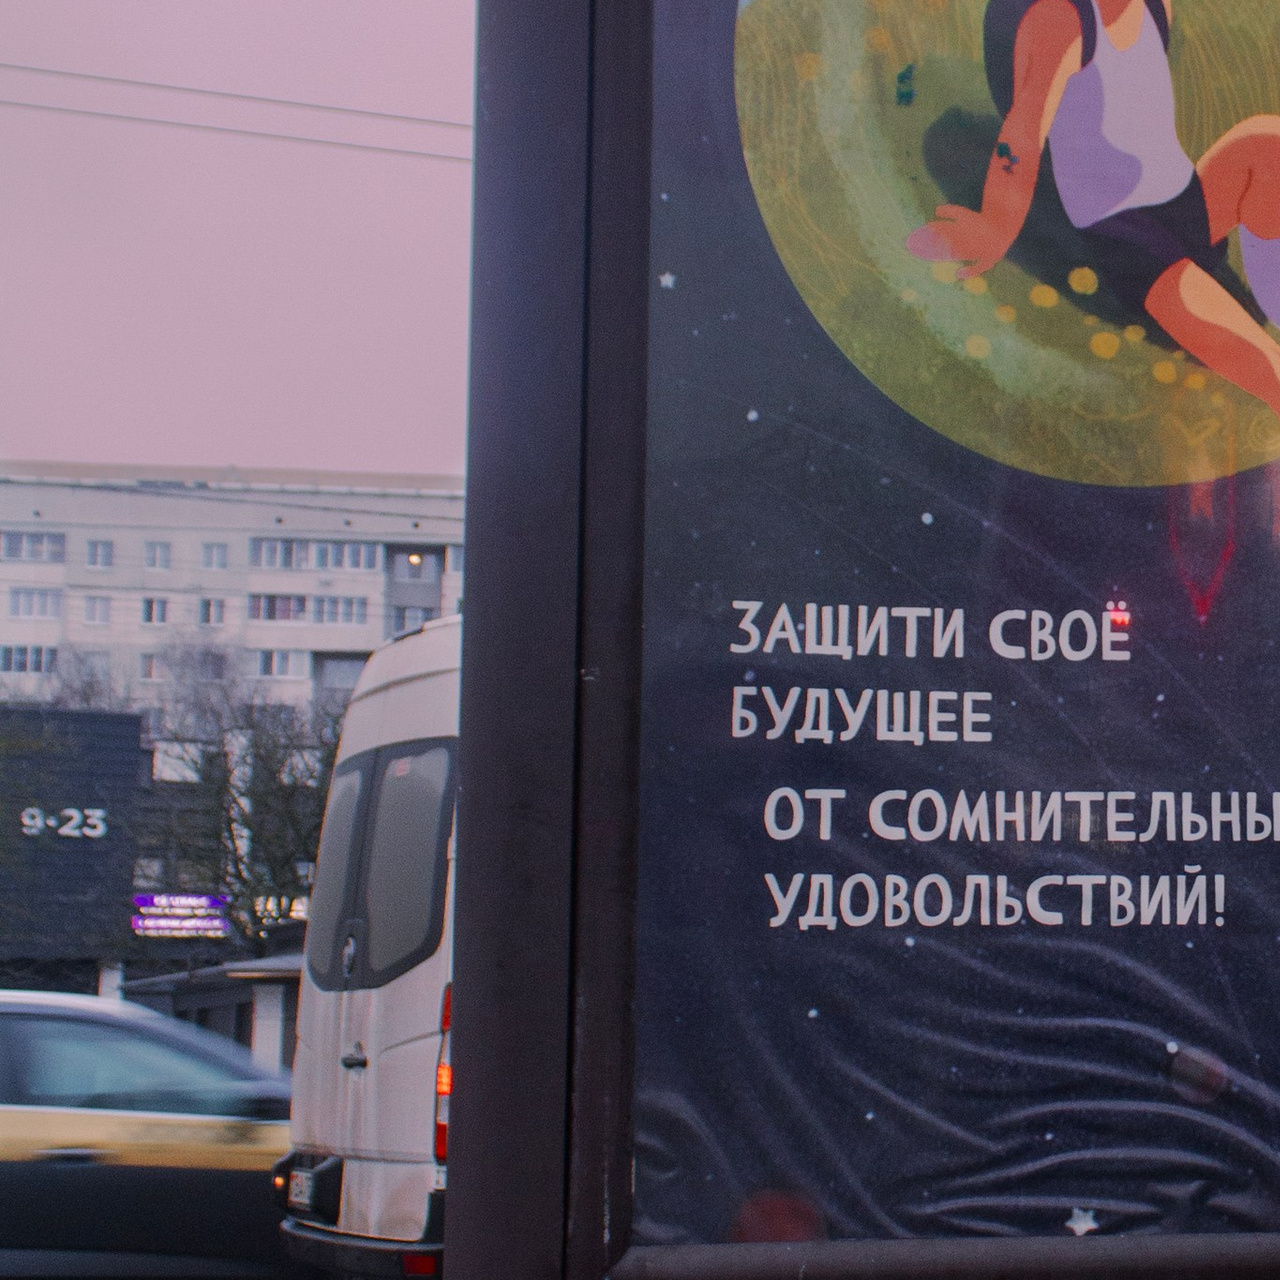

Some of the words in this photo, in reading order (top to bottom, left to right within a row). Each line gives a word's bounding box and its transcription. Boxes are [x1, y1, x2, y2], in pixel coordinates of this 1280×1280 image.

[729, 599, 965, 659] ЗАЩИТИ
[989, 600, 1131, 662] СВОЁ
[730, 686, 993, 746] БУДУЩЕЕ
[763, 787, 846, 841] ОТ
[764, 864, 1226, 931] УДОВОЛЬСТВИЙ!
